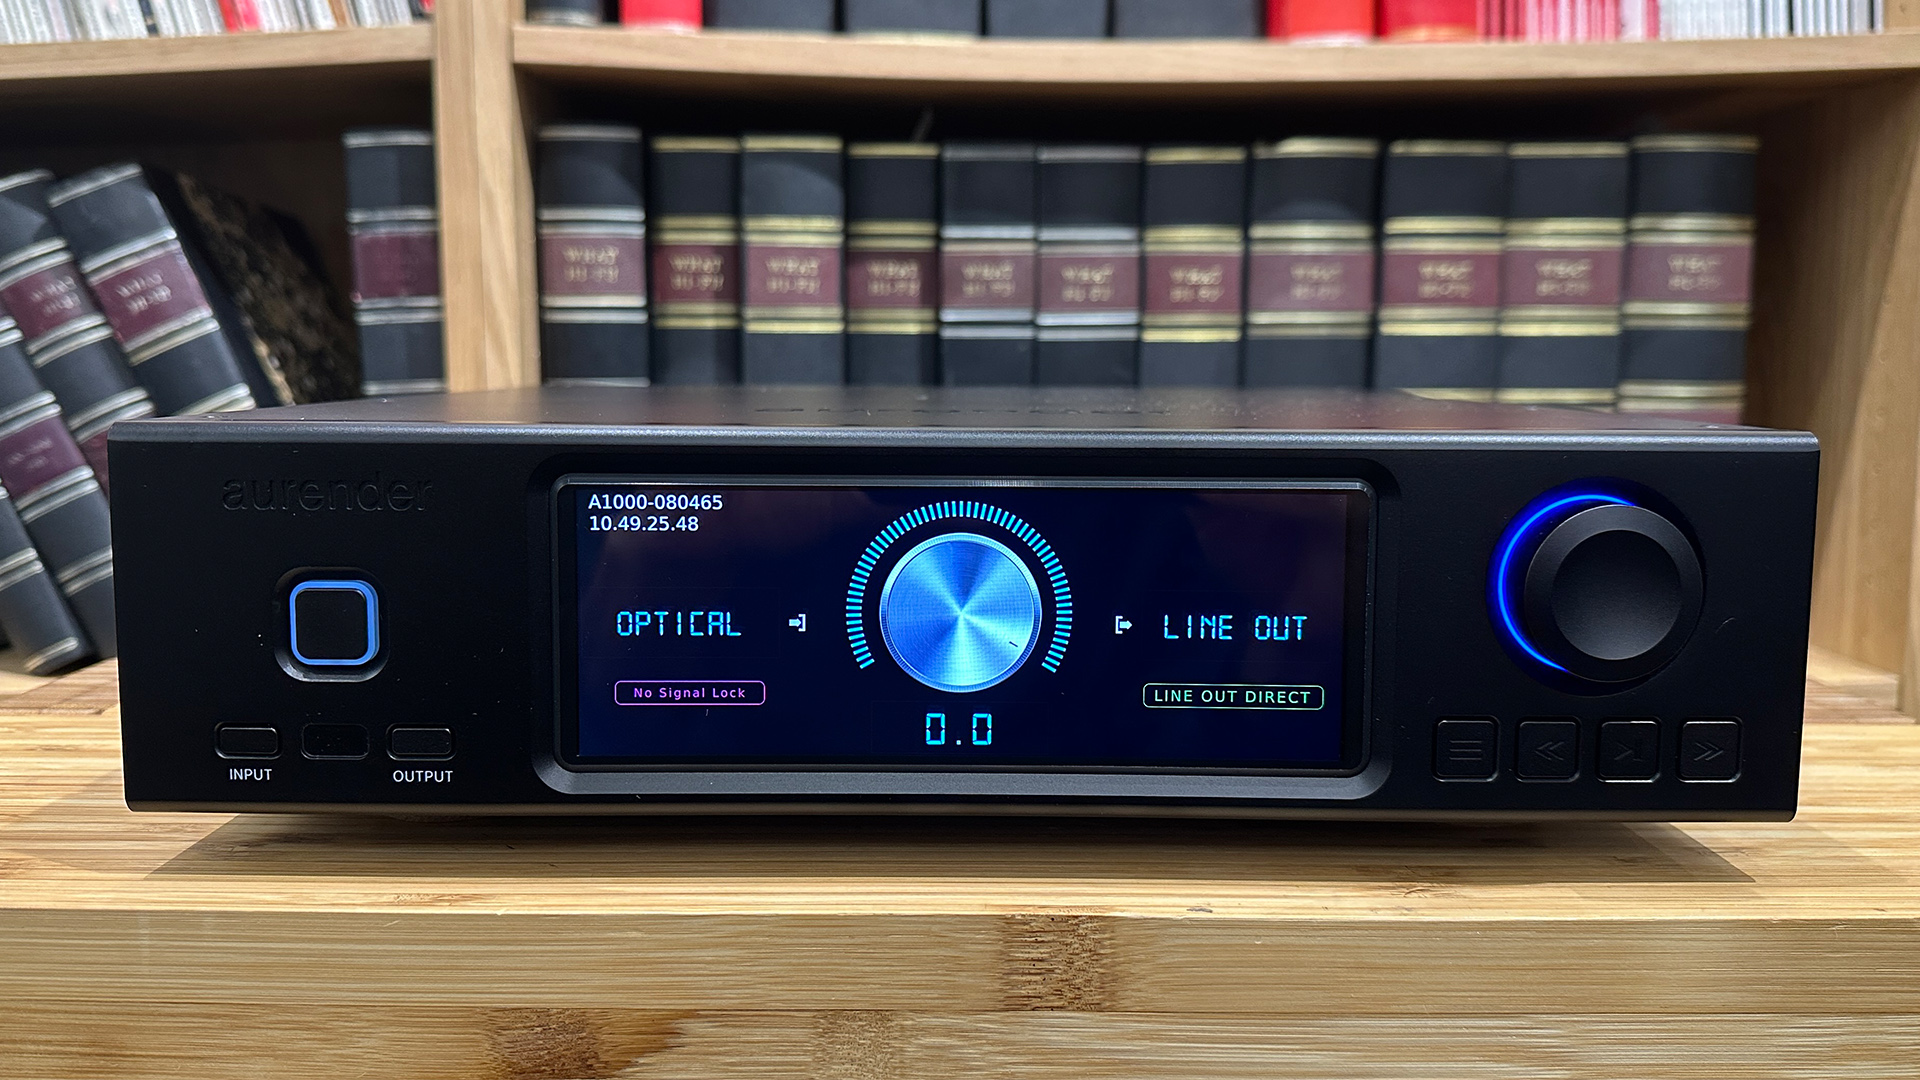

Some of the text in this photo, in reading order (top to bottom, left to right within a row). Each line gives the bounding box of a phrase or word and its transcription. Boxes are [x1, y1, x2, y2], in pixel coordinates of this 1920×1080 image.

[222, 472, 432, 511] aurender
[588, 494, 723, 510] A1000-080465
[589, 516, 699, 532] 10.49.25.48
[616, 611, 742, 637] OPTICAL
[1163, 614, 1308, 641] LINE OUT
[633, 686, 746, 700] No Signal Lock
[1154, 689, 1311, 704] LINE OUT DIRECT
[925, 712, 993, 746] 0.0
[229, 768, 273, 781] INPUT
[392, 770, 454, 783] OUTPUT
